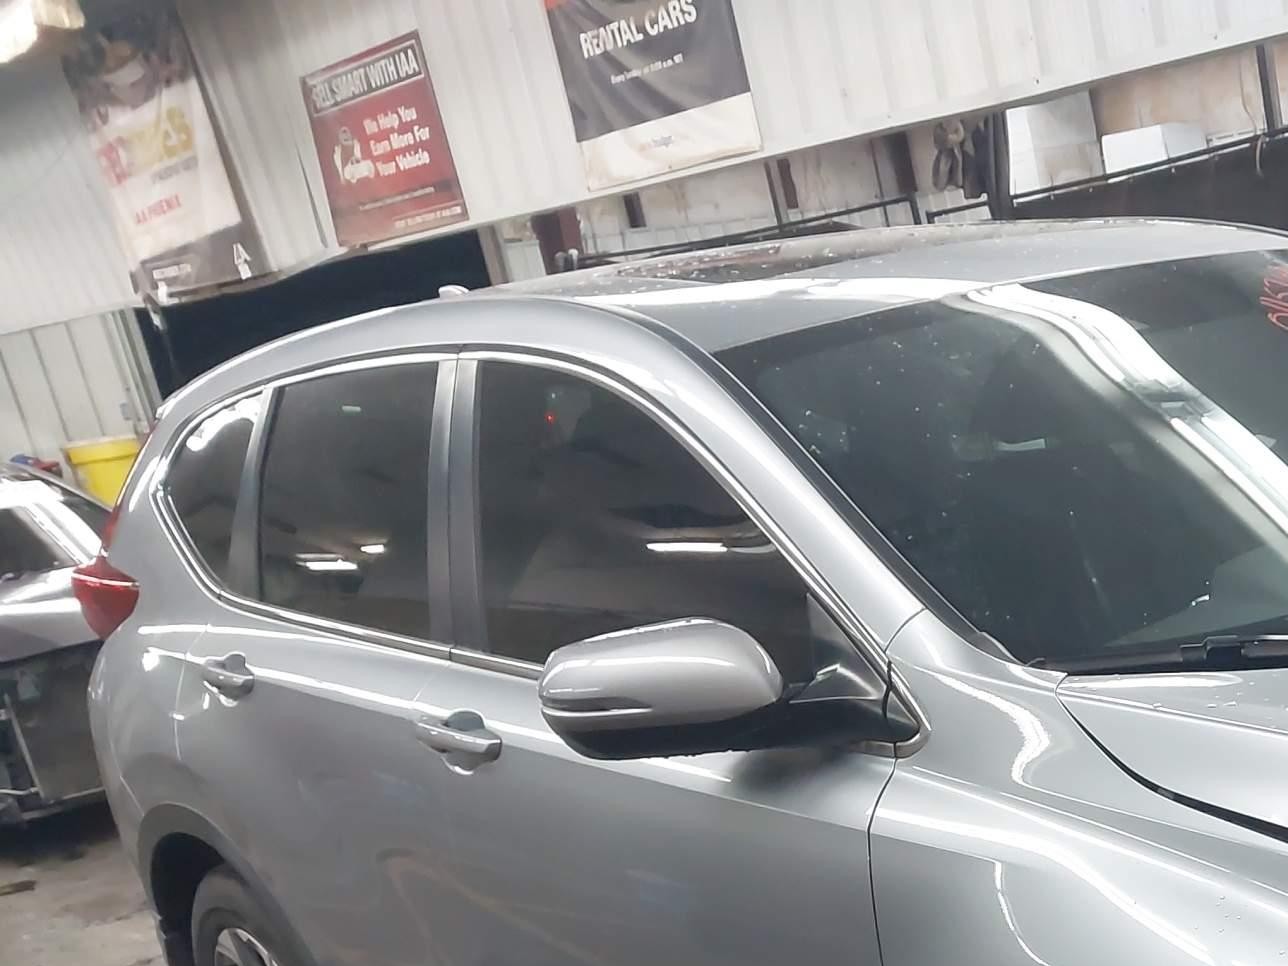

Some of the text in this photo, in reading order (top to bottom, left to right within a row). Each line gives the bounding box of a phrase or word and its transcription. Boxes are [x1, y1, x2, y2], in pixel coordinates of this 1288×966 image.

[579, 0, 697, 59] RENTAL CARS
[330, 67, 368, 102] SMART
[366, 55, 398, 89] WITH
[394, 48, 419, 78] IAA
[377, 111, 399, 130] Help
[397, 105, 417, 123] You
[369, 124, 430, 156] Earn More For
[375, 148, 430, 177] Your Vehicle
